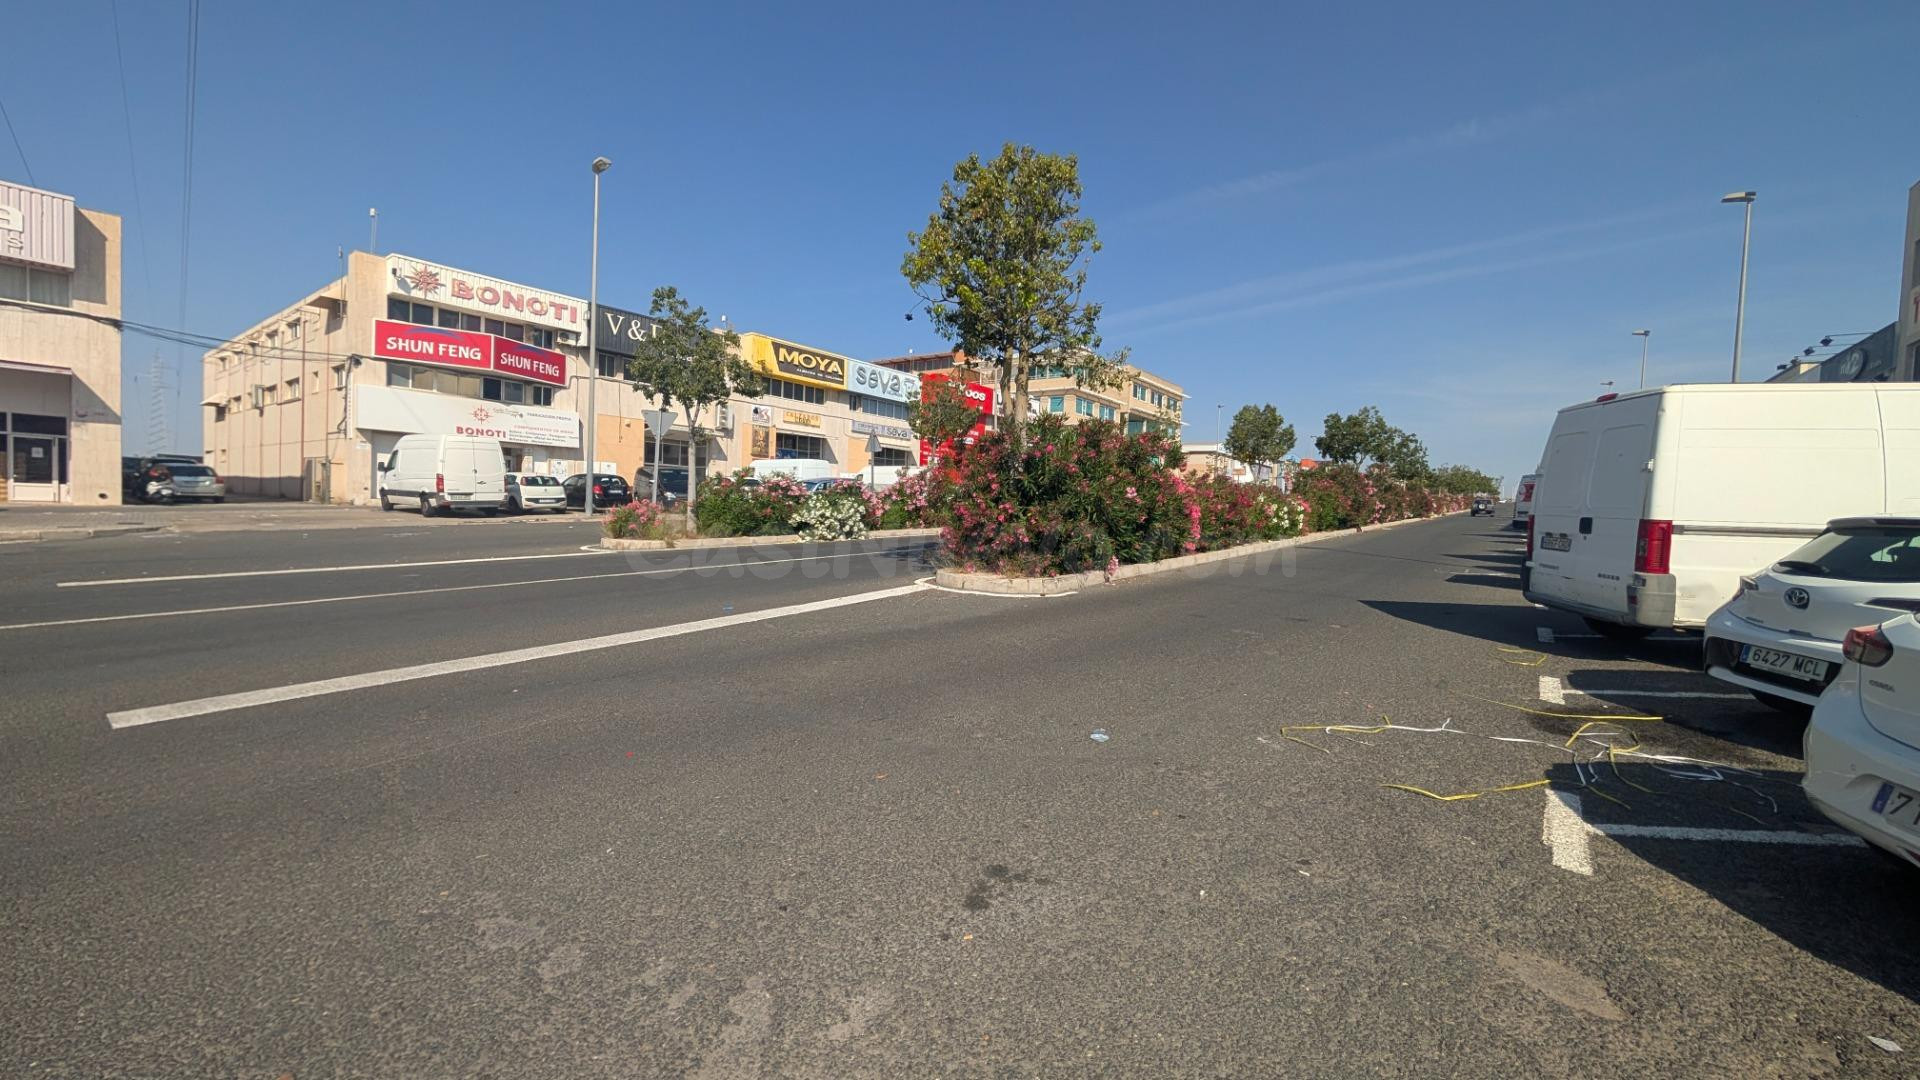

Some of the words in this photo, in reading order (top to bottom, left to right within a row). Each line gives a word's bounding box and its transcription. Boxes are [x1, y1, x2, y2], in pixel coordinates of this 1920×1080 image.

[451, 278, 577, 323] BONOTI
[386, 336, 434, 355] SHUN
[438, 343, 482, 361] FENG
[778, 347, 844, 376] MOYA
[500, 352, 531, 371] SHUN
[533, 359, 560, 377] FENG
[456, 426, 506, 438] BONOTI
[1752, 648, 1791, 669] 6427
[1792, 656, 1822, 677] MCL
